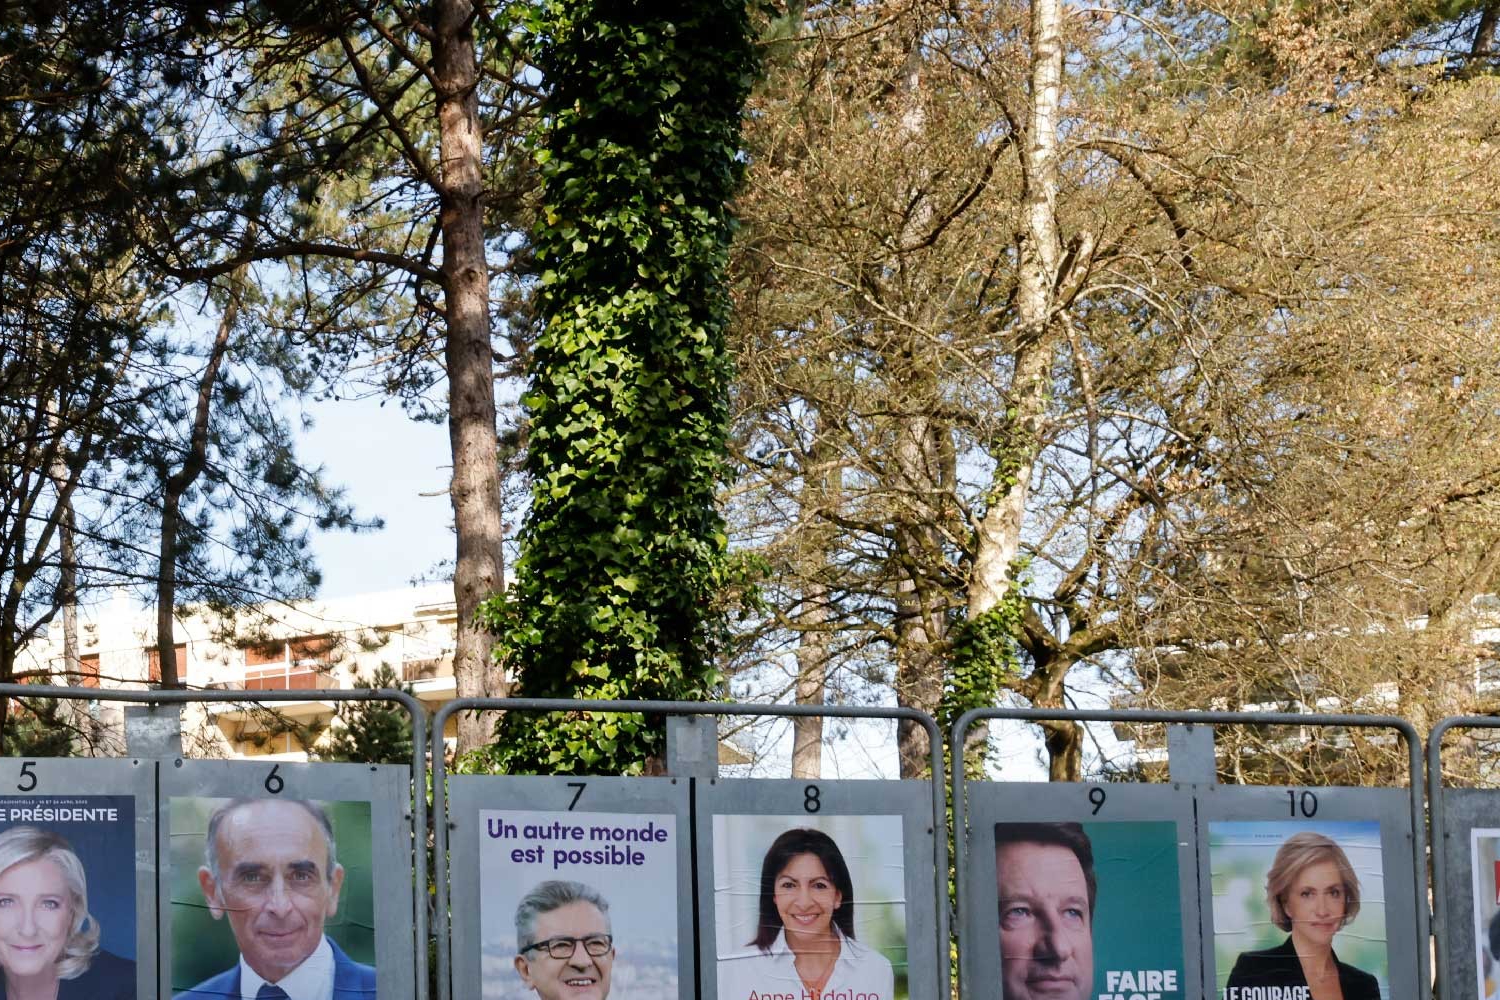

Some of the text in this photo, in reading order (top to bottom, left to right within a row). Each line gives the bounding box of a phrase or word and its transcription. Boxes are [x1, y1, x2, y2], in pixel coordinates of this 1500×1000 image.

[17, 761, 37, 792] 5
[265, 764, 284, 794] 6
[567, 782, 587, 811] 7
[804, 784, 820, 813] 8
[1089, 787, 1106, 815] 9
[1287, 790, 1318, 818] 10
[10, 805, 118, 822] PRÉSIDENTE
[487, 818, 668, 842] Un autre monde
[510, 845, 645, 870] est possible
[1106, 970, 1178, 993] FAIRE
